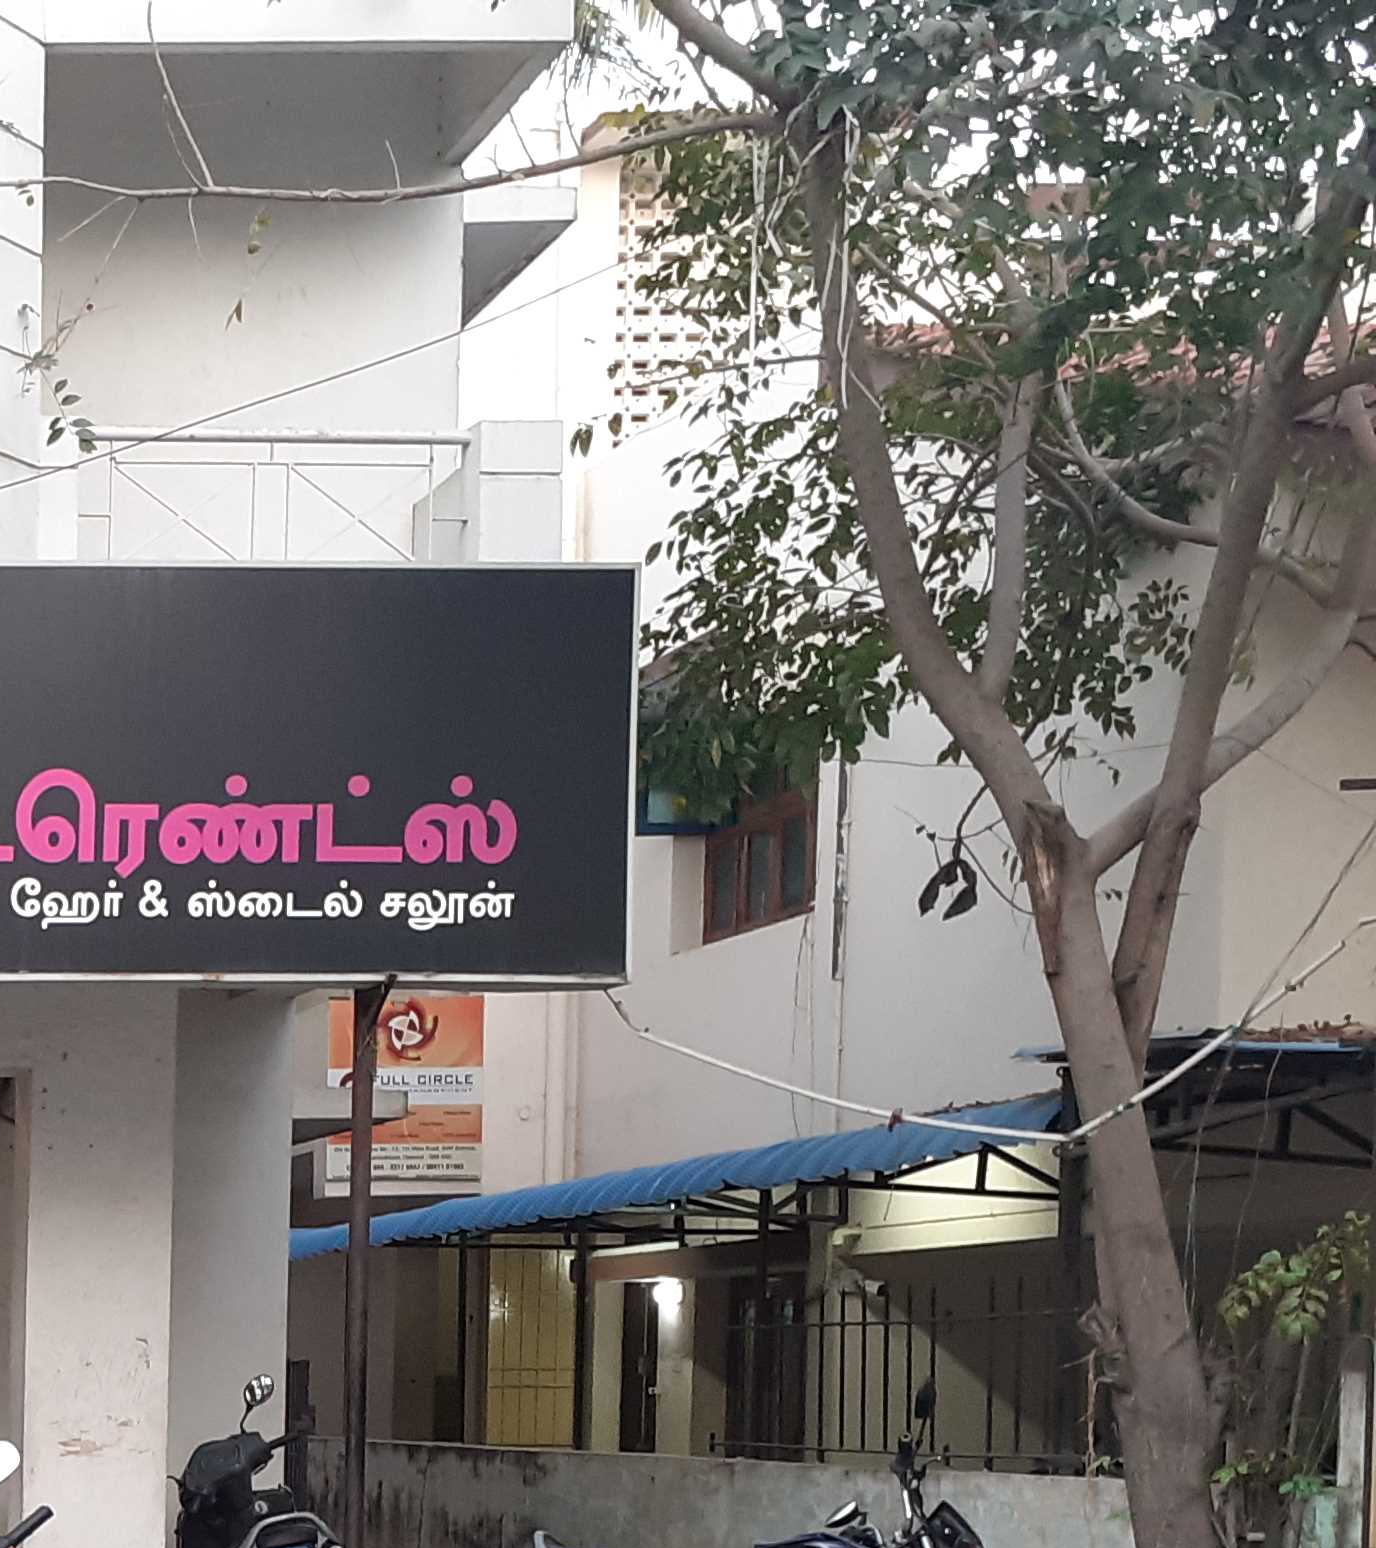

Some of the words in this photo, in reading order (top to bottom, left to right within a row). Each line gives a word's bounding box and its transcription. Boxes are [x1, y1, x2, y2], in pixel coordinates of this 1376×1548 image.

[10, 877, 124, 930] ஹேர்
[138, 879, 169, 918] &
[187, 879, 363, 918] ஸ்டைல்
[379, 880, 515, 931] சலூன்
[417, 1074, 474, 1086] CIRCLE
